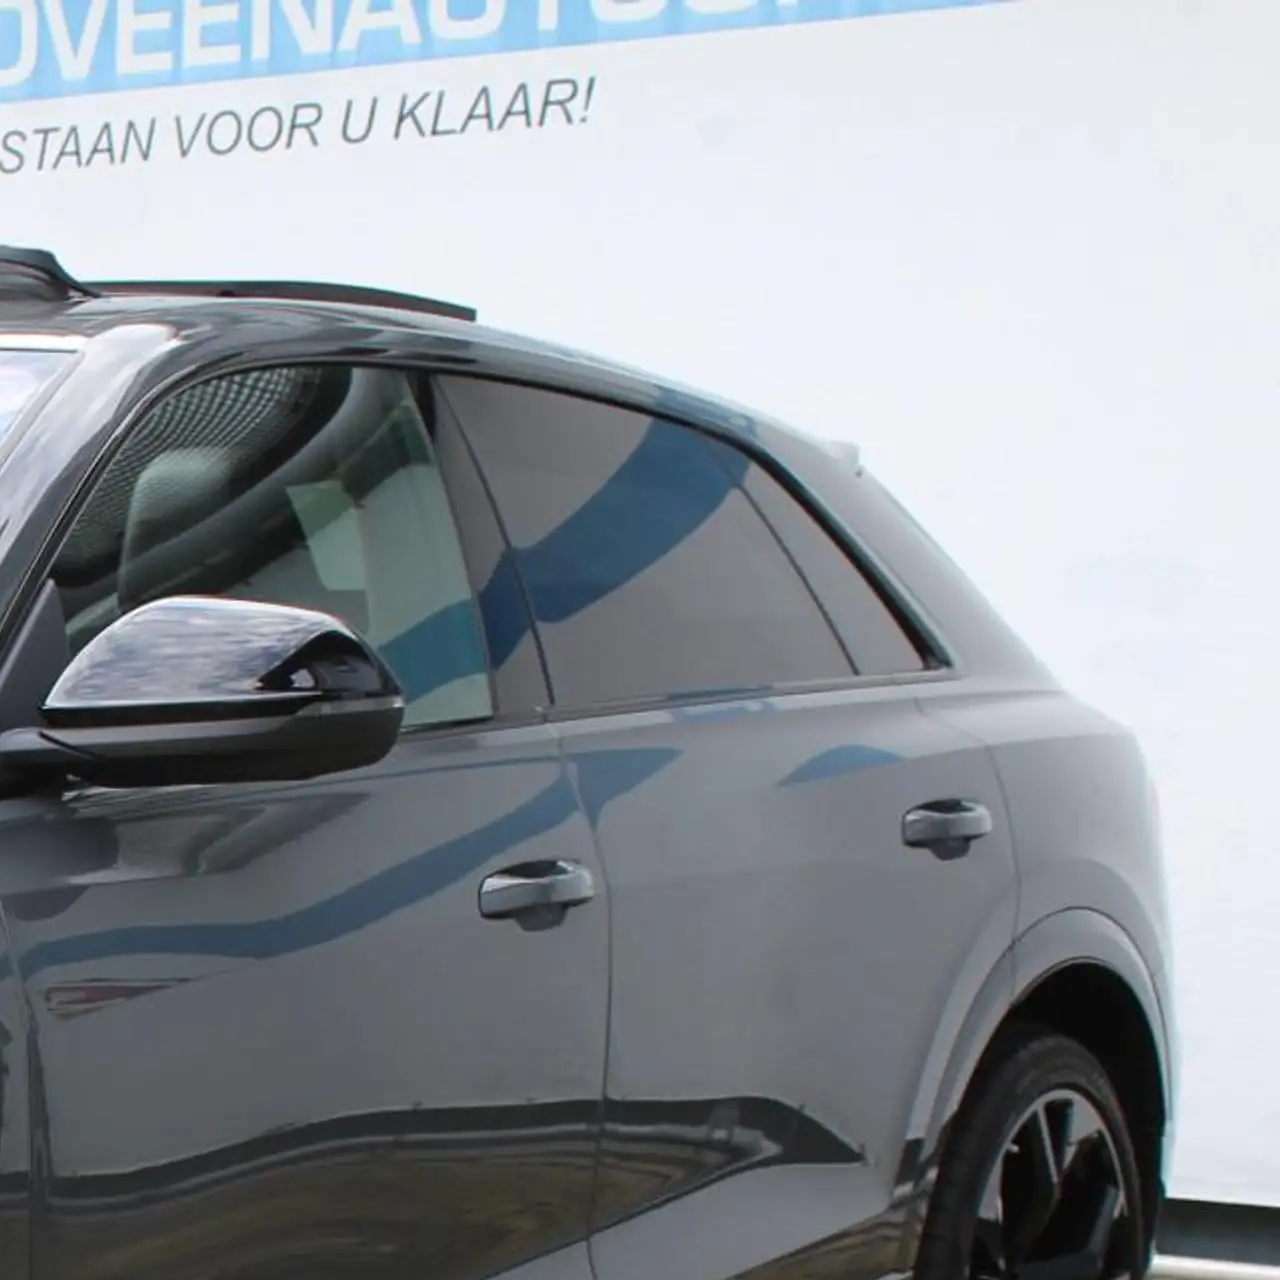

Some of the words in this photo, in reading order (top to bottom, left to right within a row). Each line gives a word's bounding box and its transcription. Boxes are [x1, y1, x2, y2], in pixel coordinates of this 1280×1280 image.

[173, 102, 326, 159] VOOR
[340, 96, 380, 145] U
[393, 76, 597, 140] KLAAR!
